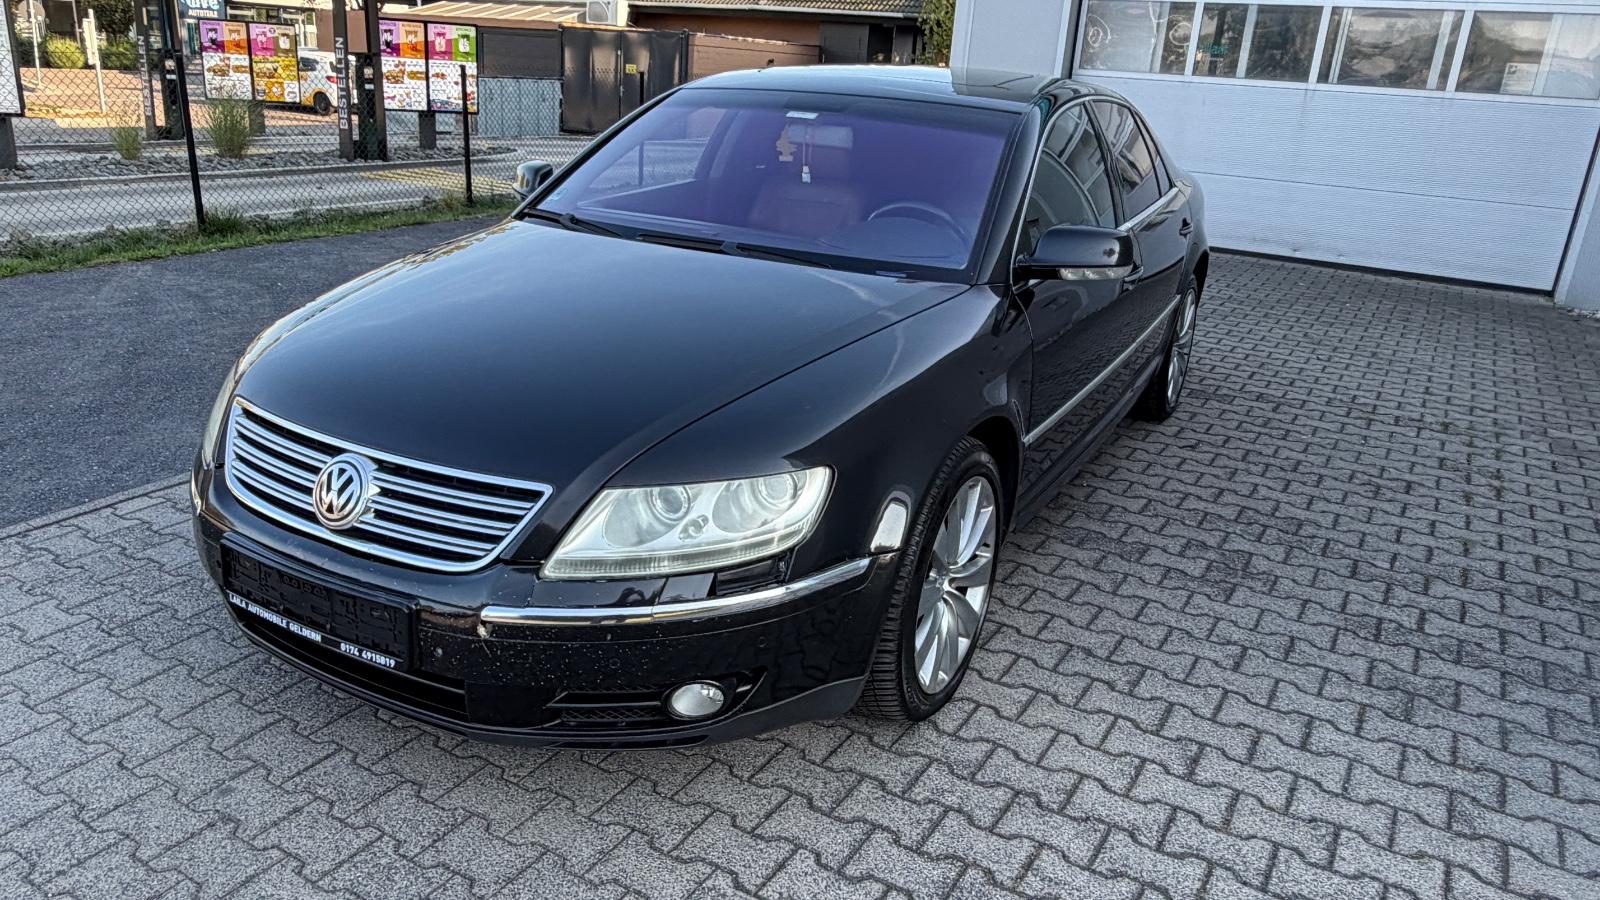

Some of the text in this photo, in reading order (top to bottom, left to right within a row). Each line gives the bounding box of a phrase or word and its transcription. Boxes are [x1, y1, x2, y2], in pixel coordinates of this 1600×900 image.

[188, 9, 218, 18] AUTOTEILE
[137, 35, 152, 116] BESTELLEN
[335, 37, 349, 129] BESTELLEN
[319, 461, 362, 521] VW
[247, 603, 288, 629] AUTOMOBILE
[289, 622, 321, 643] GELDERN
[340, 642, 360, 657] 0174
